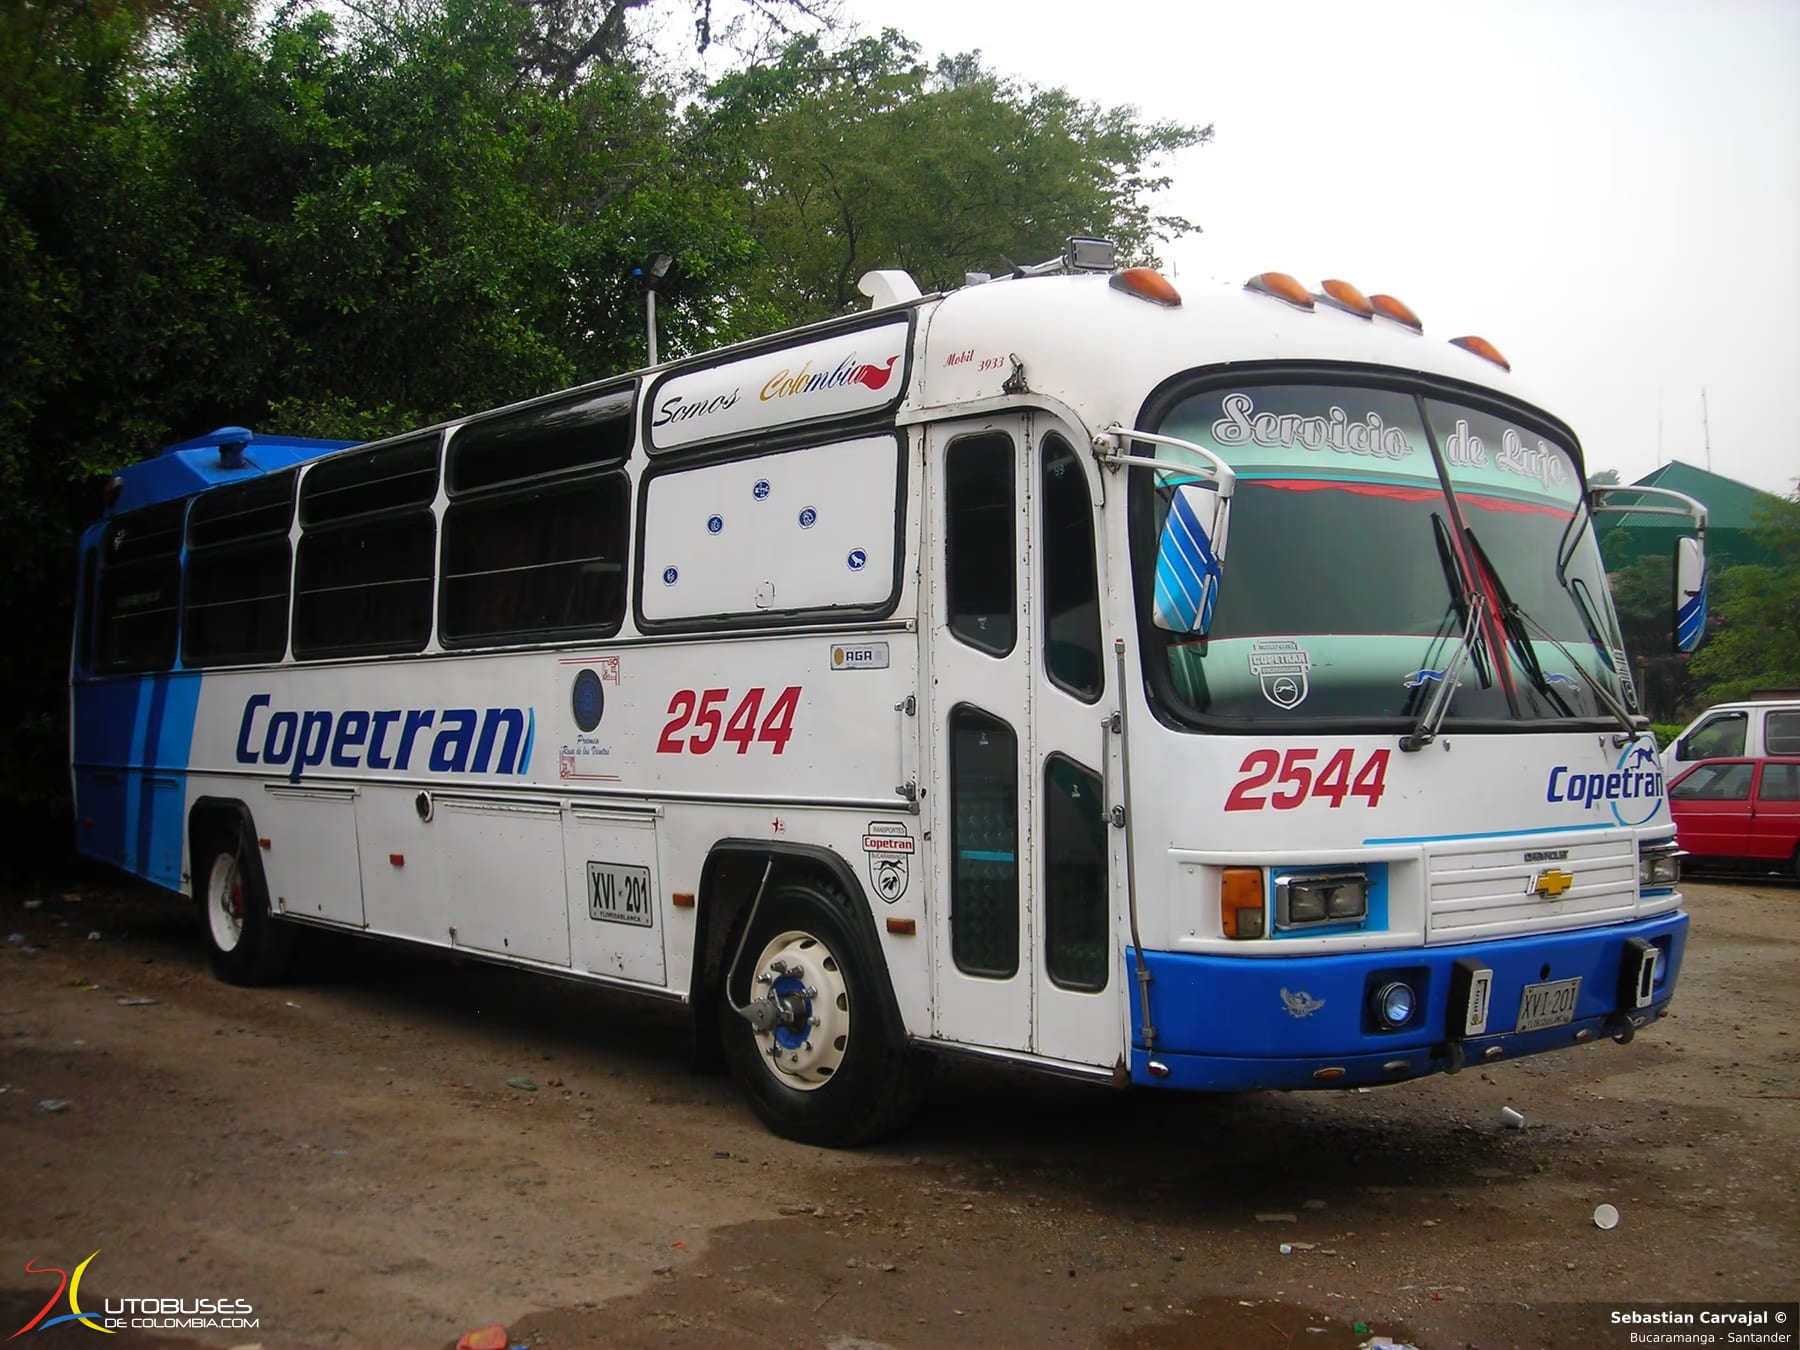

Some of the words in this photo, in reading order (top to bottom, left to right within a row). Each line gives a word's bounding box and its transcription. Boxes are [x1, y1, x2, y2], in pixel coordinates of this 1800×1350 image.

[943, 349, 975, 368] Mobil
[977, 356, 1005, 373] 3933
[653, 387, 740, 427] Somos
[759, 351, 872, 401] Colombia
[1211, 392, 1413, 458] Servicio
[1446, 419, 1487, 469] de
[1495, 428, 1568, 490] Lujo
[236, 694, 527, 783] Copetran
[656, 686, 802, 755] 2544
[1224, 748, 1391, 812] 2544
[1547, 766, 1664, 809] Copetran
[864, 837, 912, 849] Copetran
[591, 872, 616, 910] XVI
[625, 876, 648, 914] 201
[1521, 994, 1548, 1020] XVI
[1551, 986, 1577, 1013] 201
